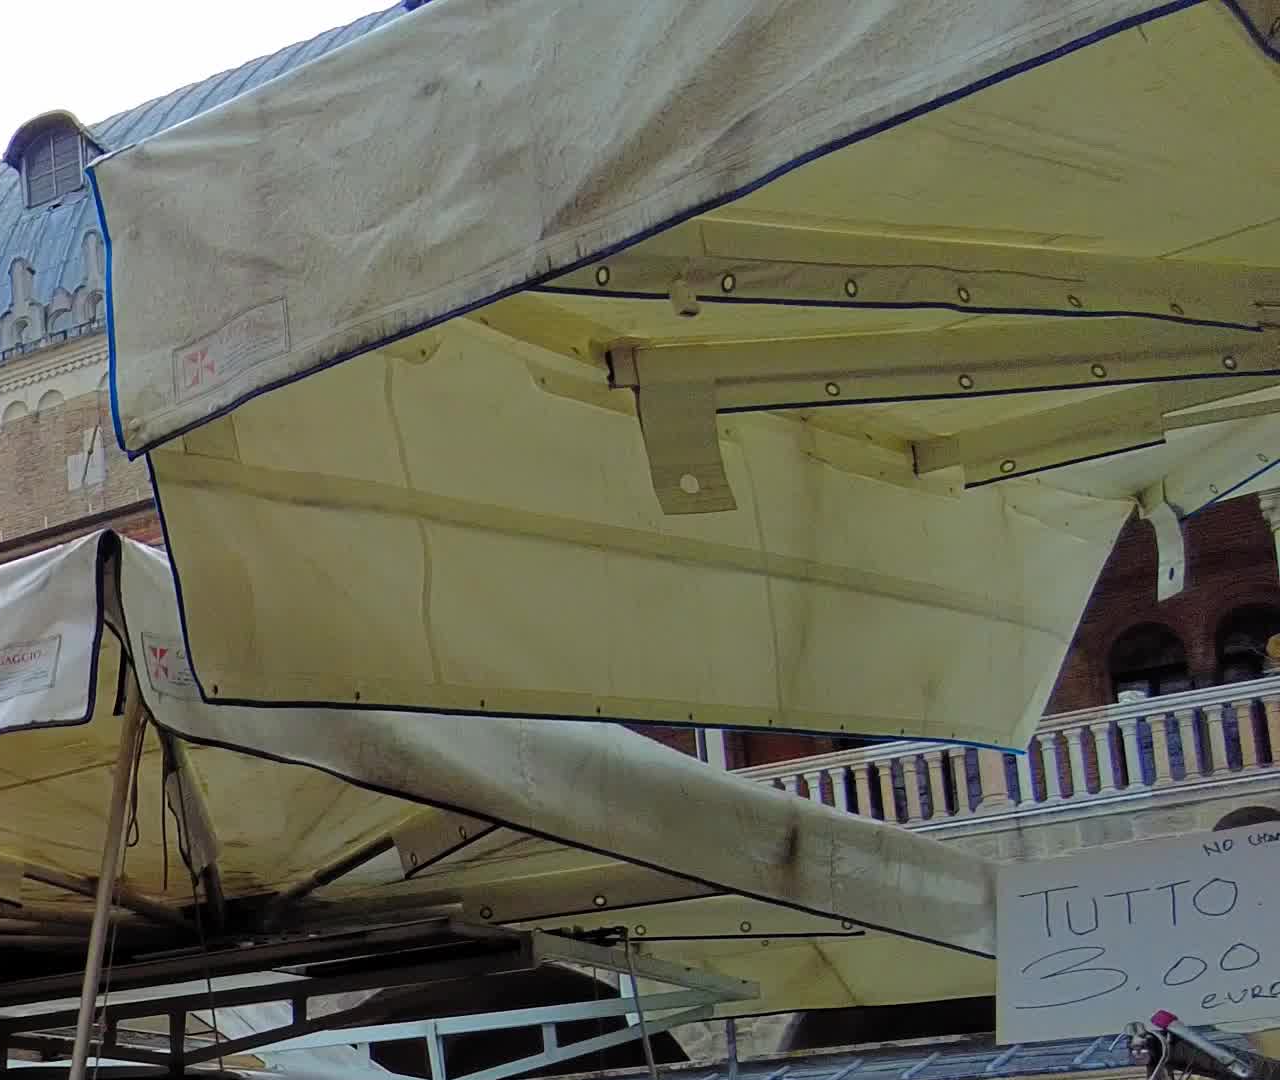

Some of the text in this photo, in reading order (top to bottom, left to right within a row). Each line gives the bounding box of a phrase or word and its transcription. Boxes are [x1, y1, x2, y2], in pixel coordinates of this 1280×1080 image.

[1202, 838, 1233, 857] NO
[1018, 877, 1239, 937] TUTTO
[1015, 942, 1261, 1010] 3.00
